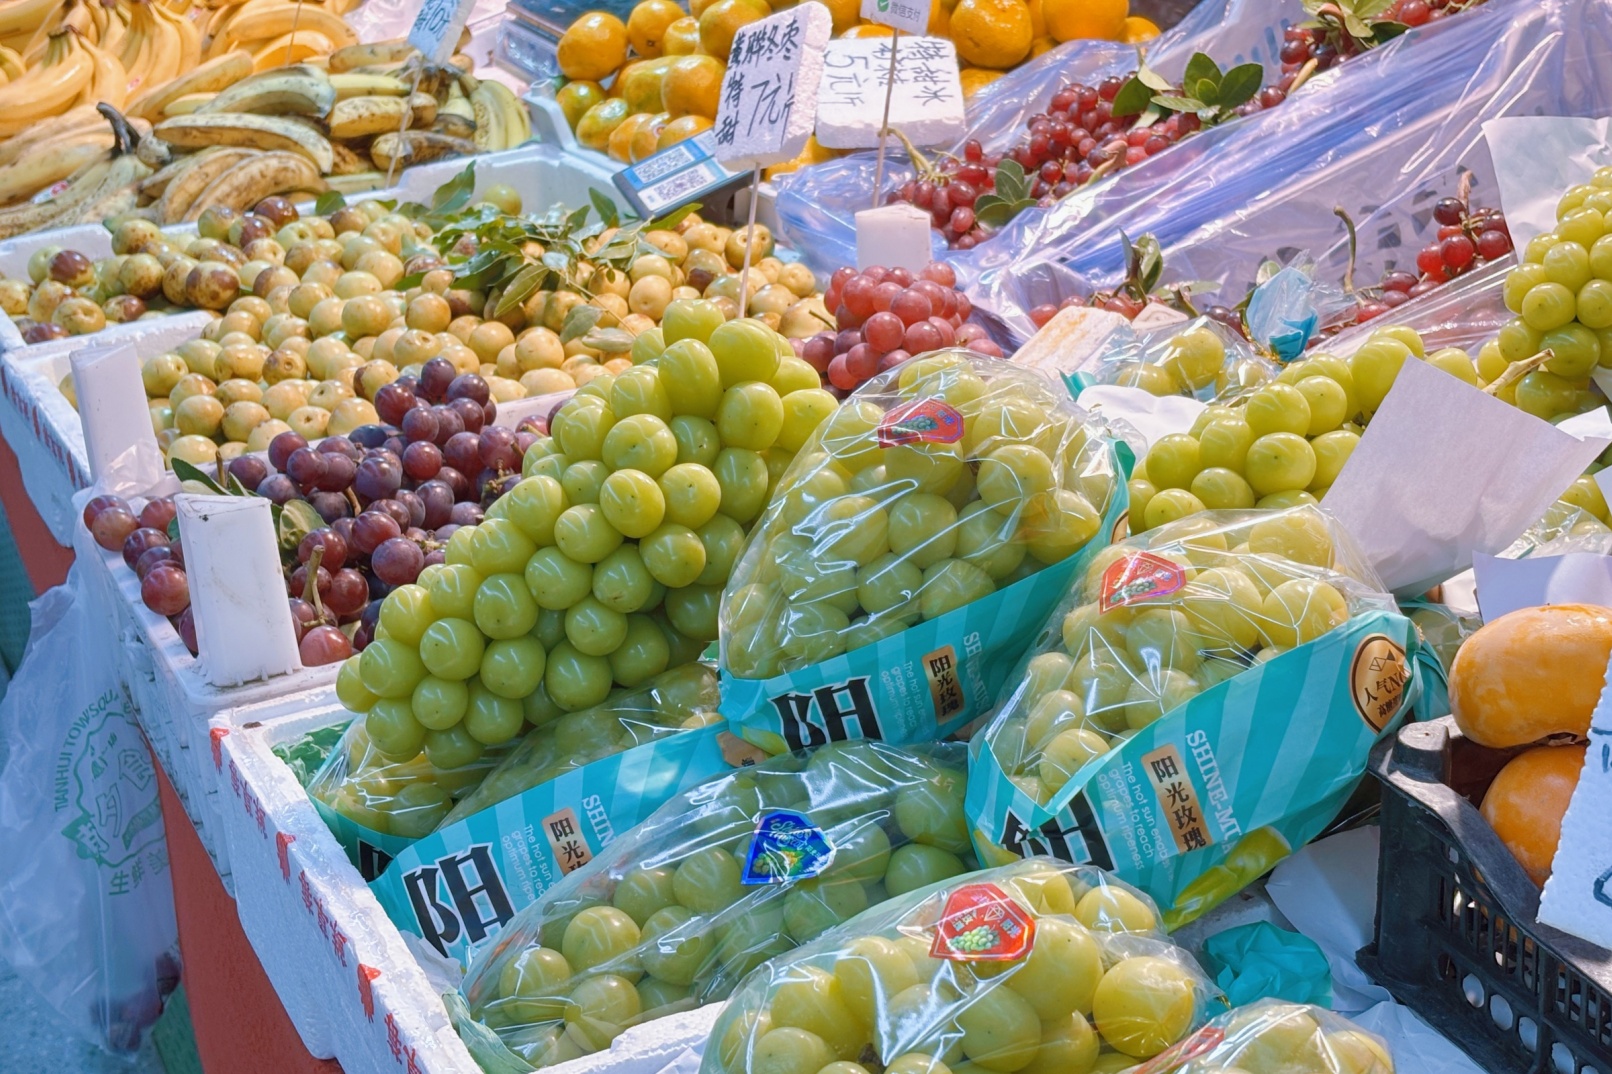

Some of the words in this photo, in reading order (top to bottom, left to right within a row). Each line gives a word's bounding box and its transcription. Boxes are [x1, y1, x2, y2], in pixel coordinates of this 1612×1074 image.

[768, 677, 883, 757] 阳
[929, 654, 960, 717] 阳光玫瑰
[55, 752, 73, 812] TIANHUI
[1108, 768, 1135, 809] grapes
[1129, 808, 1140, 823] to
[1135, 822, 1155, 859] reach
[1122, 760, 1136, 784] The
[1132, 783, 1148, 805] hot
[1141, 805, 1156, 827] sun
[1150, 755, 1207, 853] 阳光玫瑰
[511, 830, 533, 866] grapes
[528, 865, 538, 878] to
[524, 823, 536, 844] The
[531, 843, 546, 862] hot
[539, 862, 552, 881] sun
[1099, 774, 1127, 824] optimum
[1121, 823, 1145, 870] ripeness
[502, 835, 526, 880] optimum
[402, 843, 516, 958] 阳
